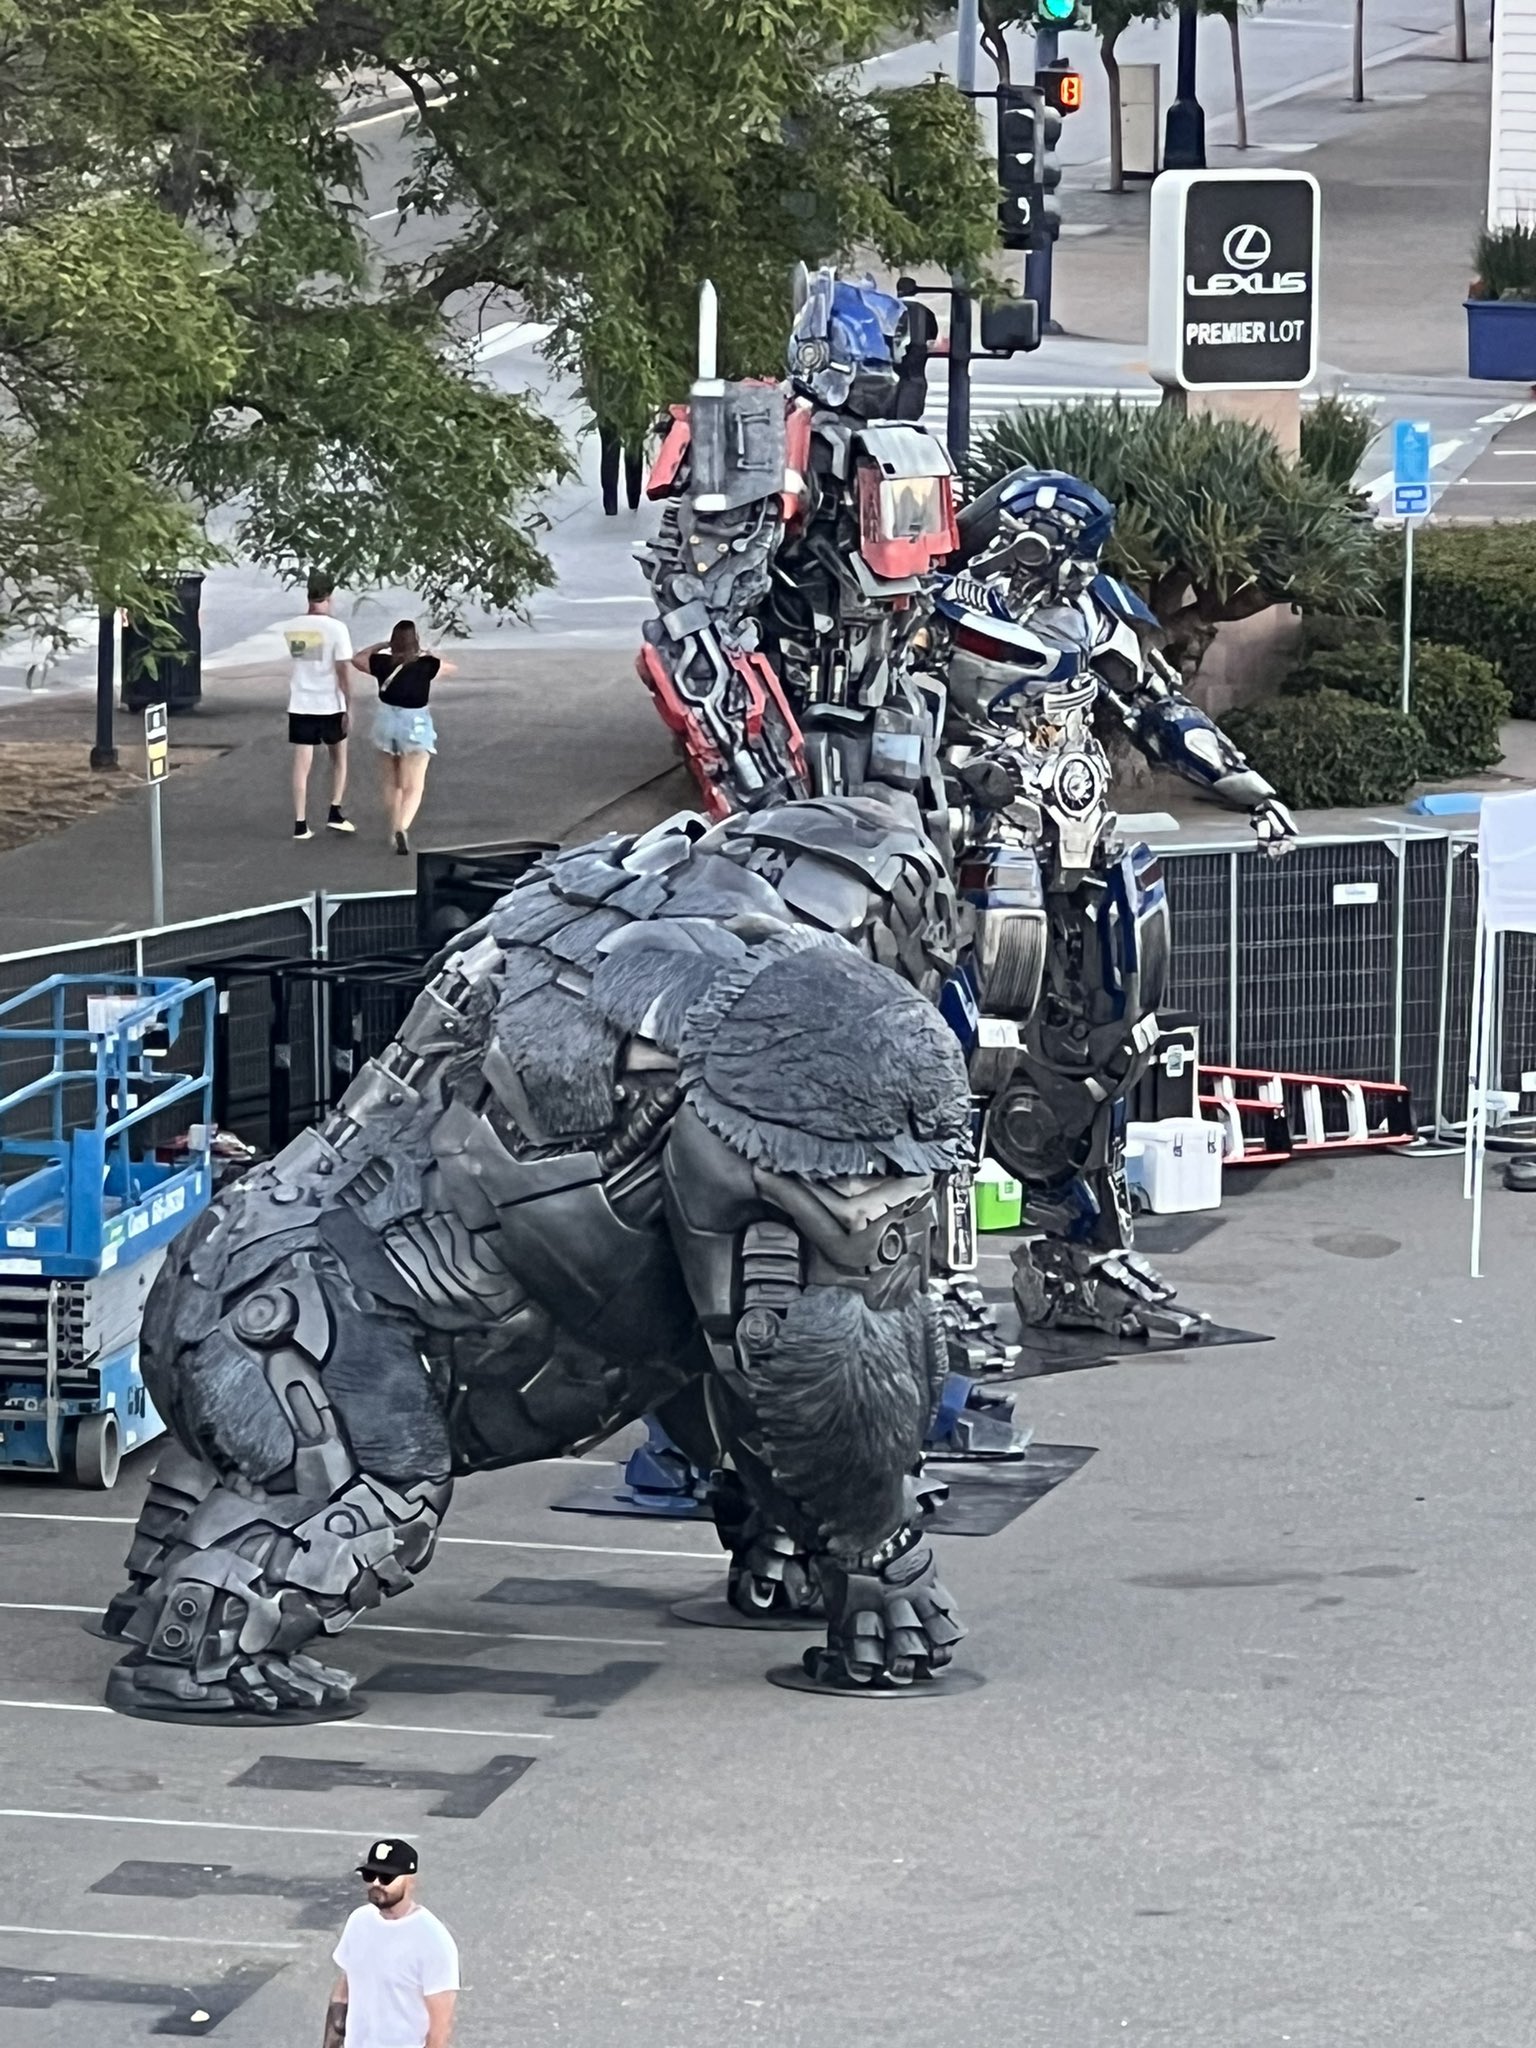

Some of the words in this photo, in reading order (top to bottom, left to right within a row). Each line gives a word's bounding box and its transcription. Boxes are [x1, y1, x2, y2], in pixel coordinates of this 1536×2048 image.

[1186, 272, 1307, 296] LEXUS
[1186, 322, 1266, 345] PREMIER
[1269, 320, 1305, 342] LOT
